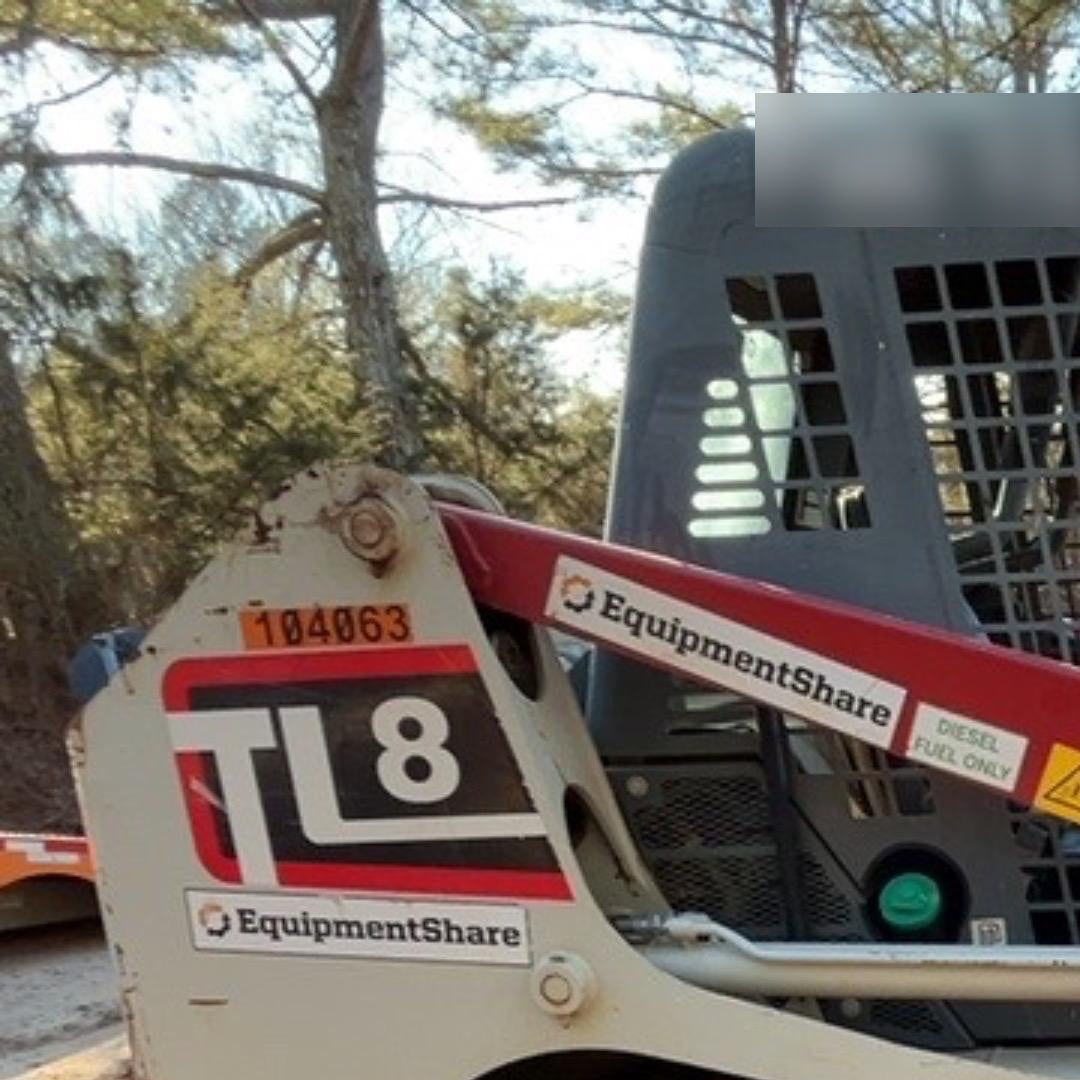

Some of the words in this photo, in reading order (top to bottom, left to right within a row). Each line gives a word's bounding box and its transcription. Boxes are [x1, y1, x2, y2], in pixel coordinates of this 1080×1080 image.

[254, 606, 411, 645] 104063
[599, 590, 893, 728] EquipmentShare
[935, 718, 1000, 753] DIESEL
[914, 738, 956, 764] FUEL
[962, 755, 1012, 781] ONLY
[236, 908, 521, 946] EquipmentShare
